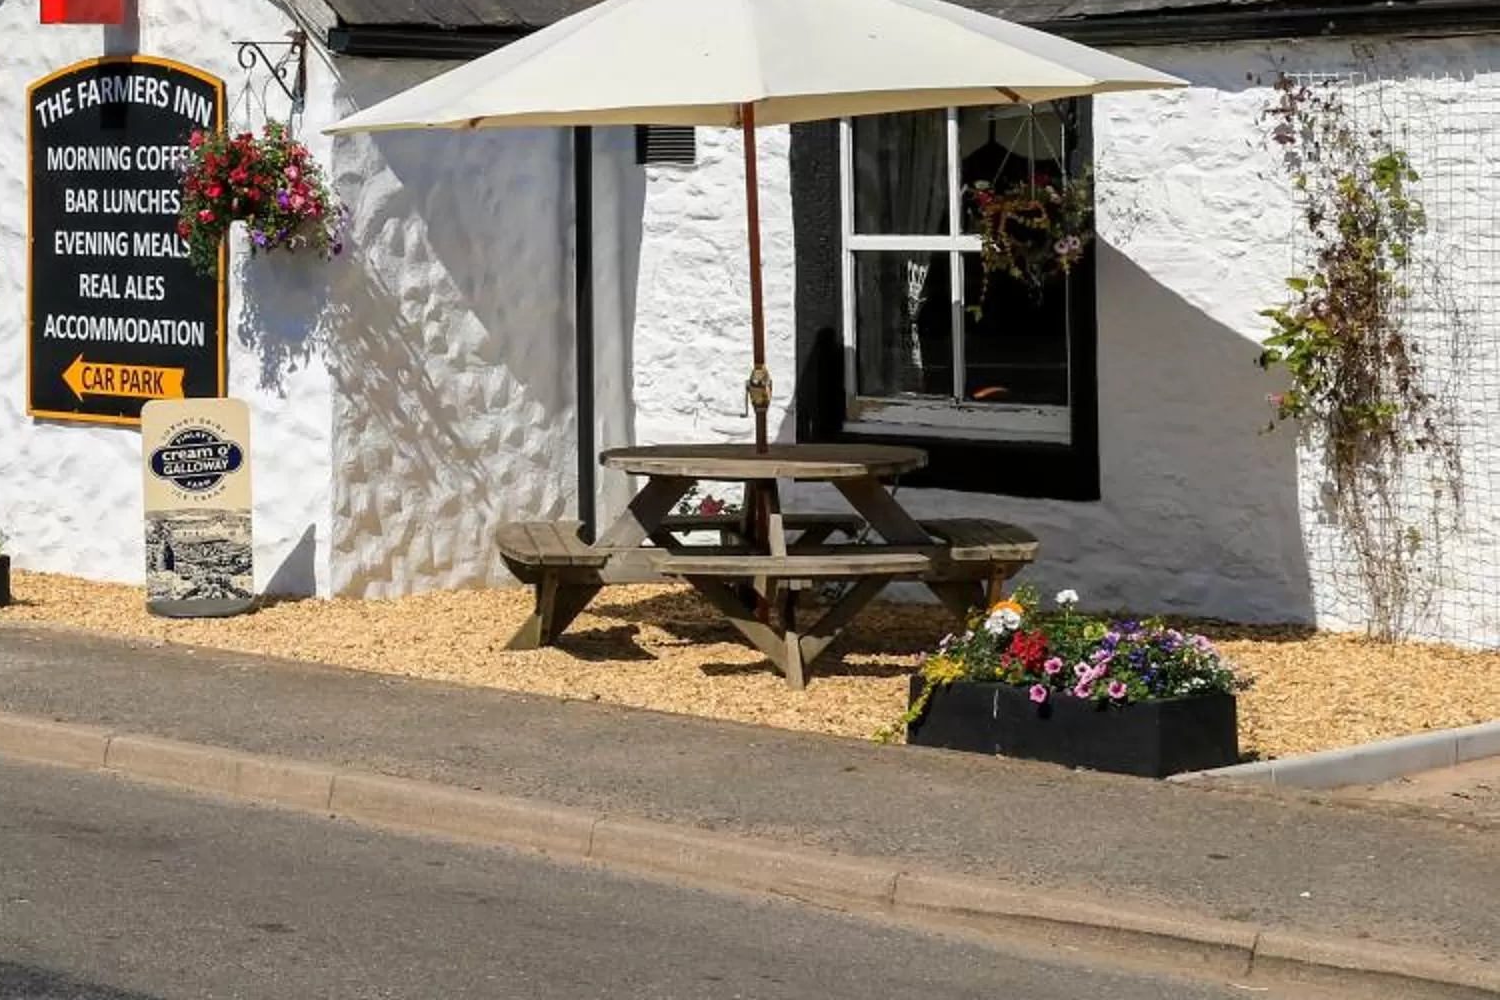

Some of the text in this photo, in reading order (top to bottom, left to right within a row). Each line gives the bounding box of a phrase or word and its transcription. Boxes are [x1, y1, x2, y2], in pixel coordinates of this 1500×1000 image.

[35, 75, 213, 129] THE FARMERS INN
[47, 146, 132, 171] MORNING
[65, 188, 181, 215] BAR LUNCHES
[54, 231, 129, 257] EVENING
[79, 273, 165, 301] REAL ALES
[43, 314, 205, 347] ACCOMMODATION
[81, 366, 164, 395] CAR PARK
[161, 447, 213, 461] cream
[163, 459, 229, 474] GALLOWAY
